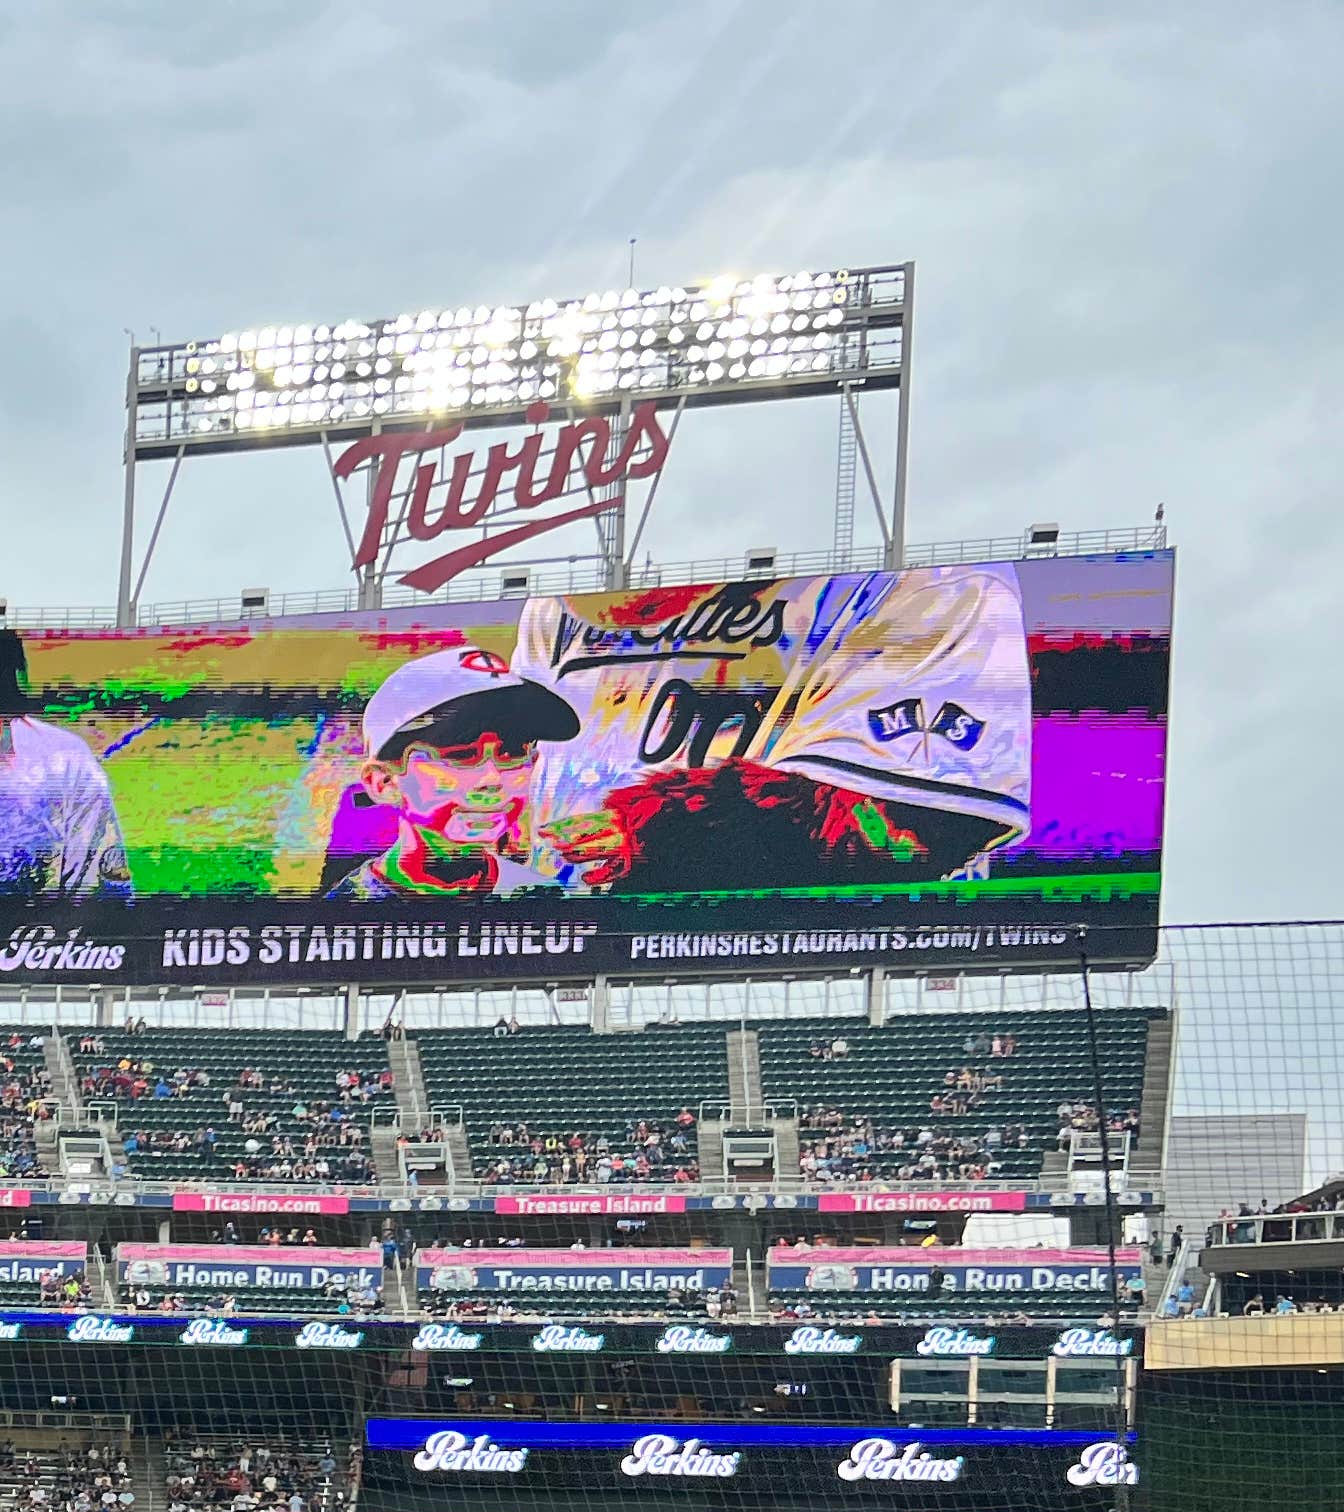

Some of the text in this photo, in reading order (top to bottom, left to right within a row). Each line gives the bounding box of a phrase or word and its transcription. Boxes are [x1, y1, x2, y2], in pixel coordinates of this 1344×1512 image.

[334, 400, 669, 593] Twins
[880, 709, 908, 736] M
[163, 920, 597, 967] KIDS STARTING LINEUP
[515, 1196, 666, 1214] Treasure Island
[176, 1264, 239, 1287] Home
[245, 1266, 304, 1288] Run
[494, 1268, 704, 1292] Treasure Island
[966, 1268, 1022, 1291] Run
[1030, 1269, 1108, 1291] Deck
[68, 1315, 134, 1343] Perkins
[180, 1318, 248, 1347] Perkins
[296, 1321, 364, 1349] Perkins
[412, 1323, 482, 1352] Perkins
[533, 1324, 604, 1353] Perkins
[657, 1325, 732, 1354] Perkins
[784, 1326, 863, 1356] Perkins
[917, 1327, 994, 1358] Perkins
[1052, 1327, 1133, 1358] Perkins
[414, 1430, 528, 1473] Perkins
[621, 1434, 740, 1477] Perkins
[837, 1438, 963, 1482] Perkins
